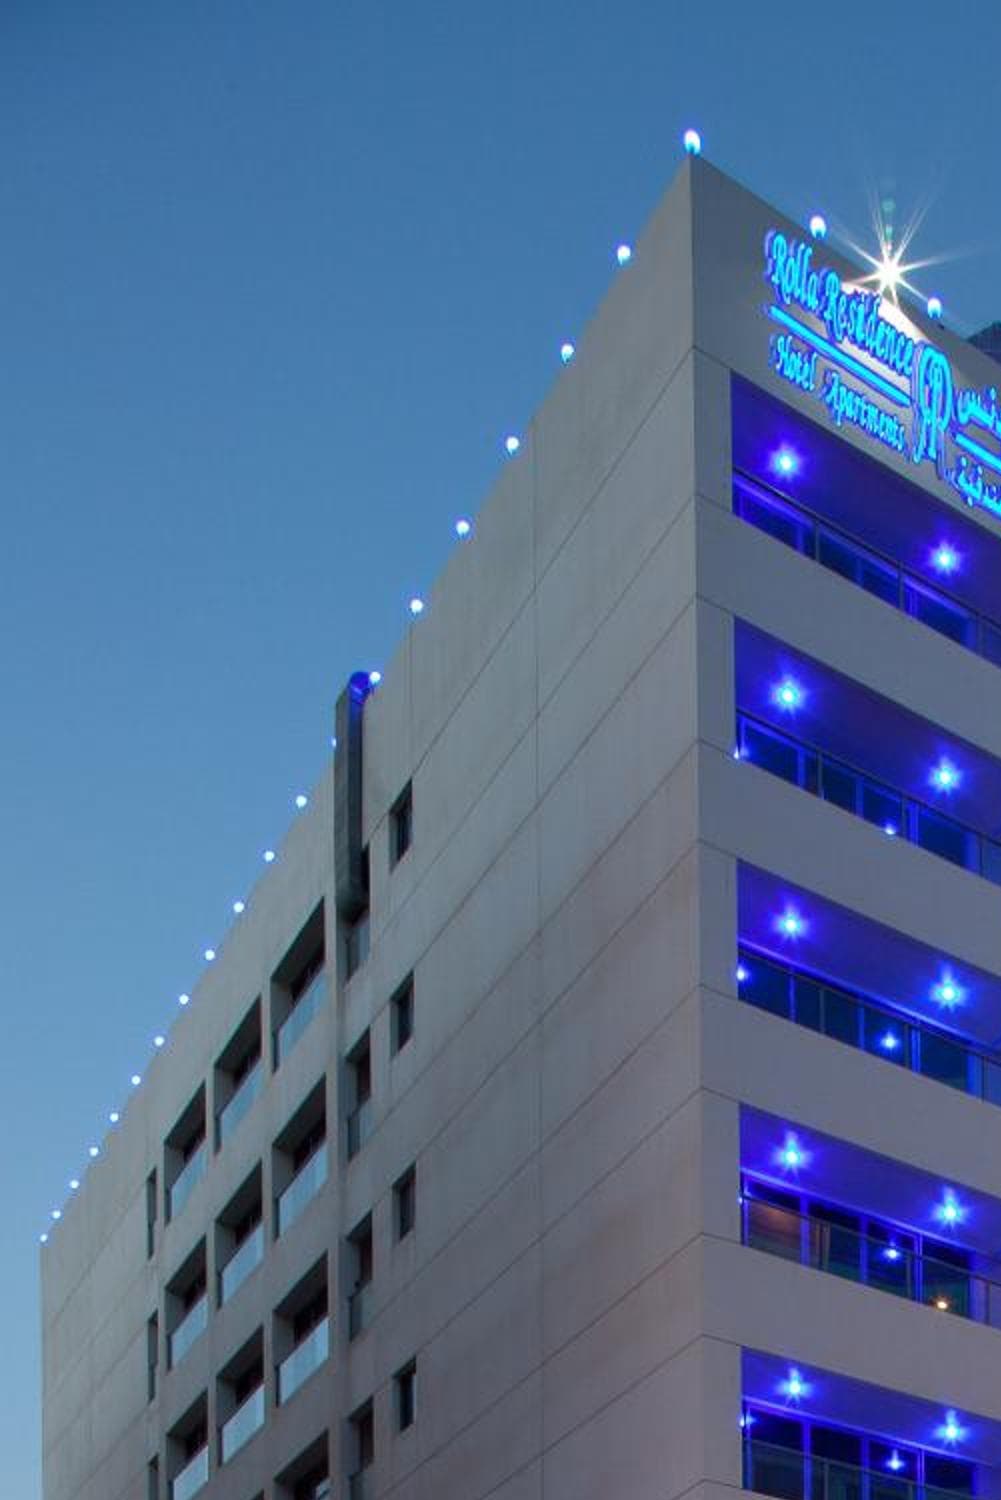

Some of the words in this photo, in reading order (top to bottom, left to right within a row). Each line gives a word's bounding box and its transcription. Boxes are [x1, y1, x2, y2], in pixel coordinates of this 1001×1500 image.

[764, 230, 819, 311] Rolla
[816, 268, 914, 377] Residence
[769, 334, 818, 391] Hotel
[822, 370, 907, 452] Apartments
